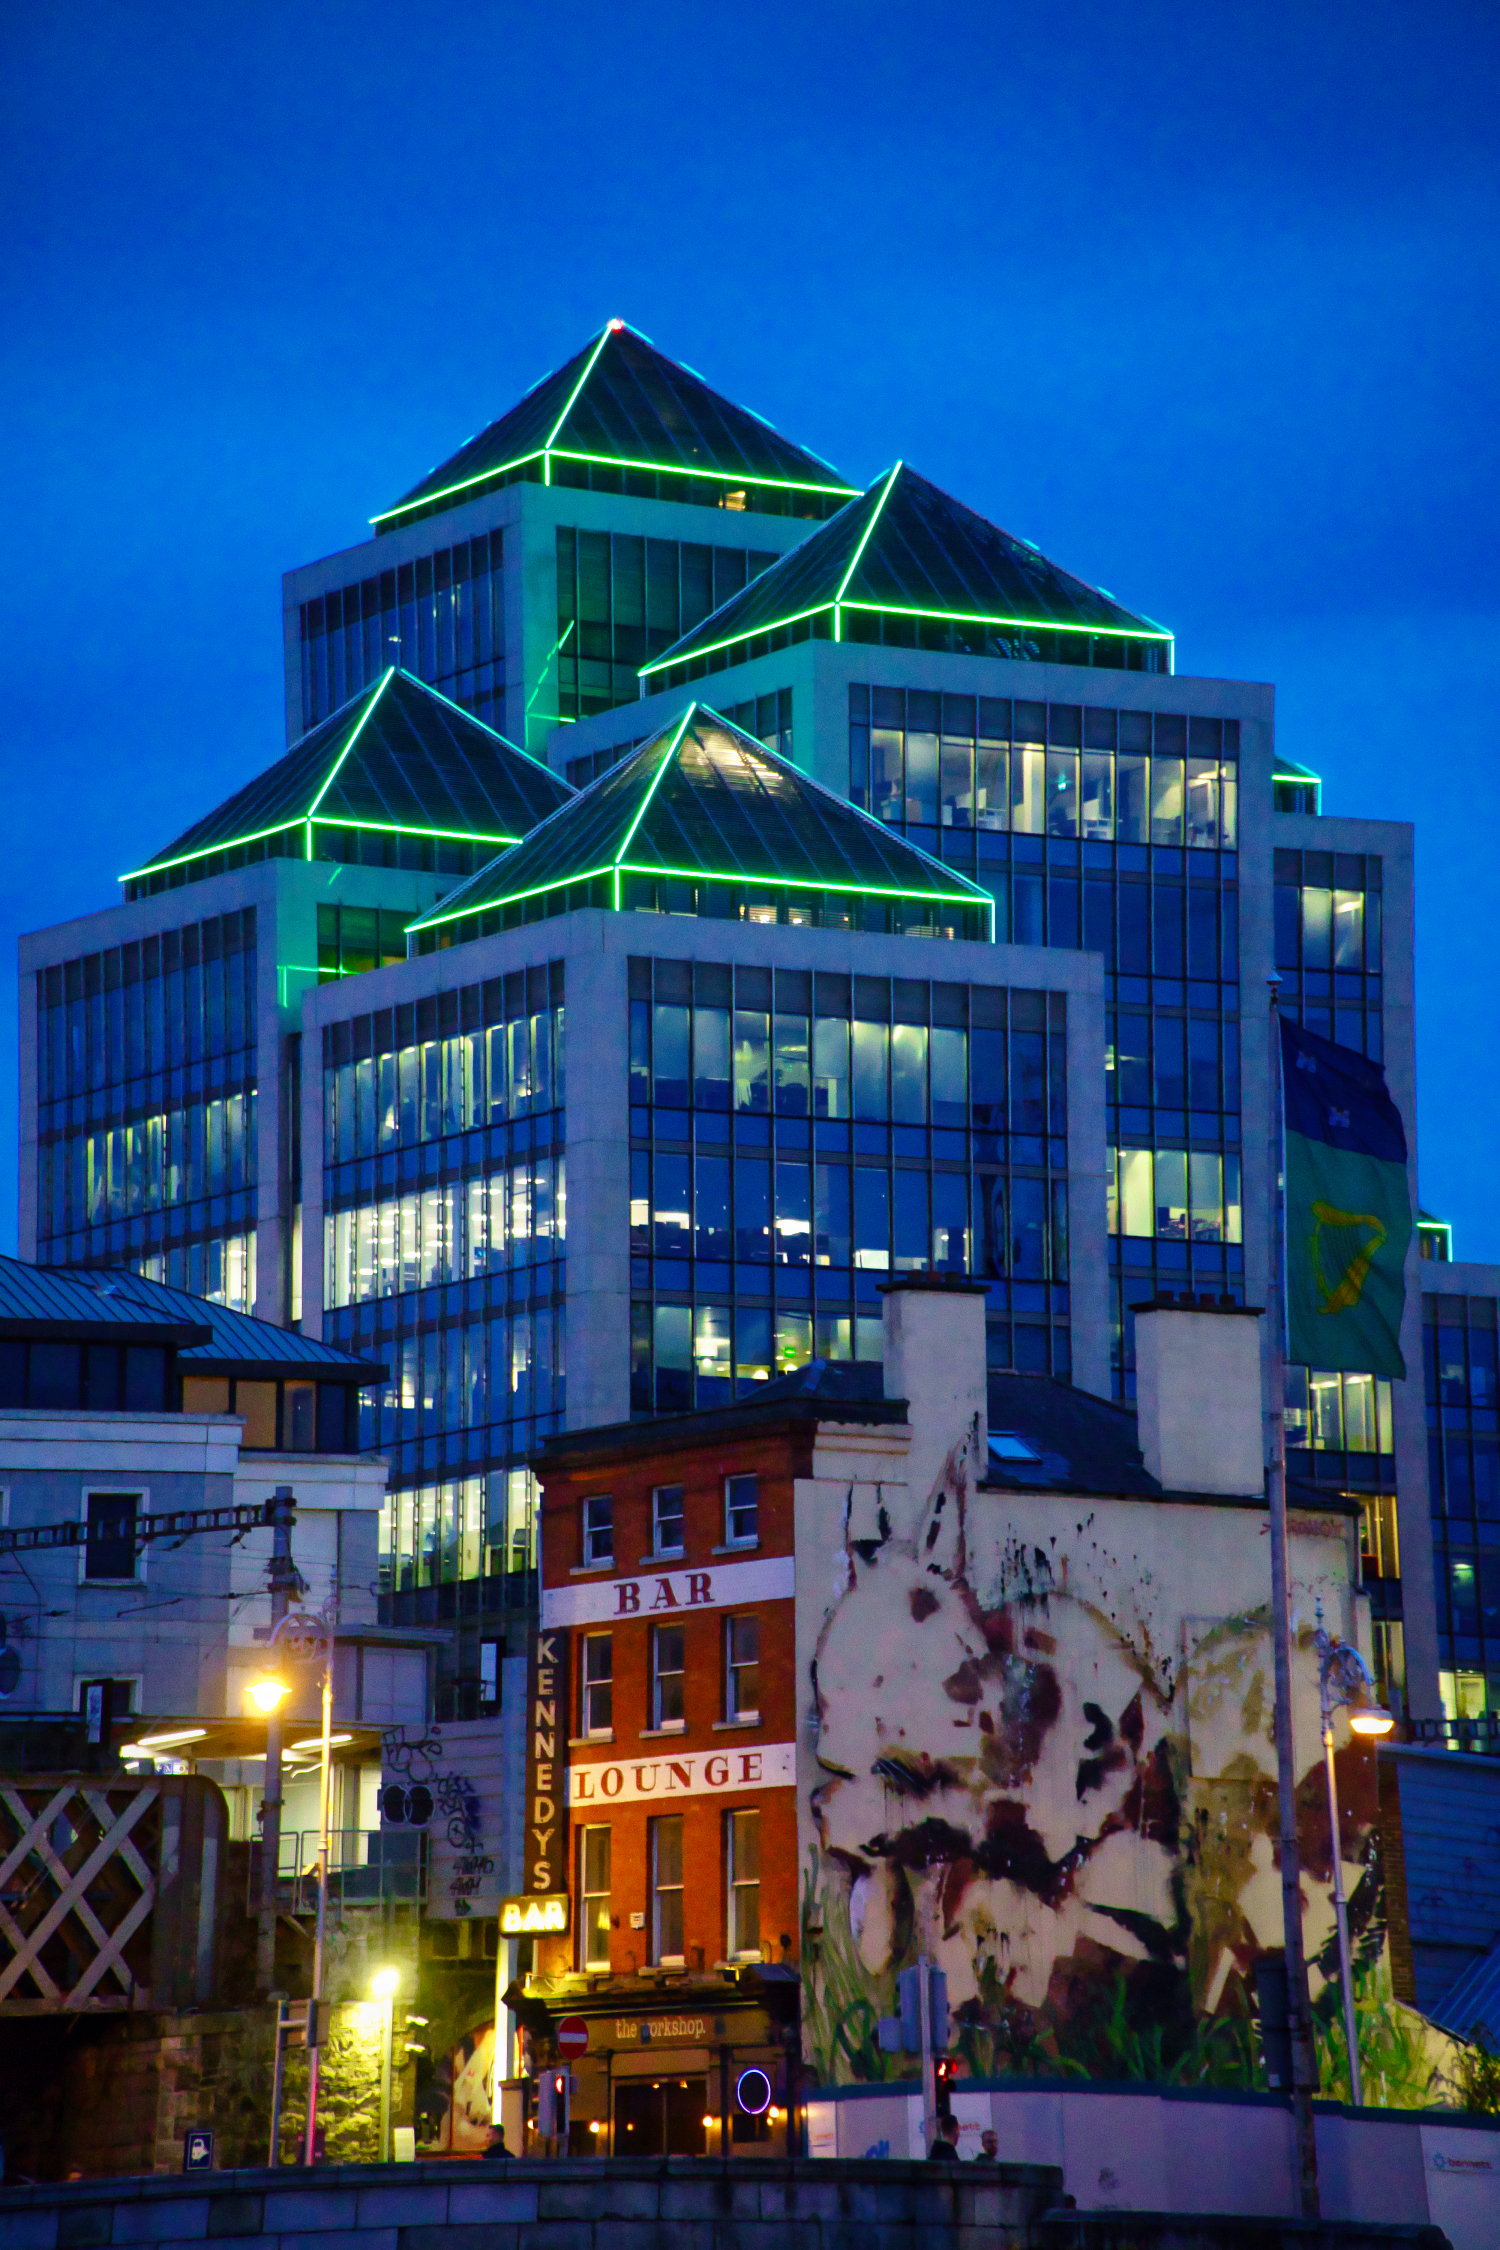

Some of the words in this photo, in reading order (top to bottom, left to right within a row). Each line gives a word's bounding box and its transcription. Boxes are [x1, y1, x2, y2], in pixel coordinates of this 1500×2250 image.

[613, 1573, 716, 1616] BAR
[532, 1637, 559, 1889] KENNEDYS
[573, 1753, 763, 1800] LOUNGE
[504, 1901, 565, 1932] BAR
[615, 2018, 637, 2039] the
[641, 2016, 706, 2039] orkshop.
